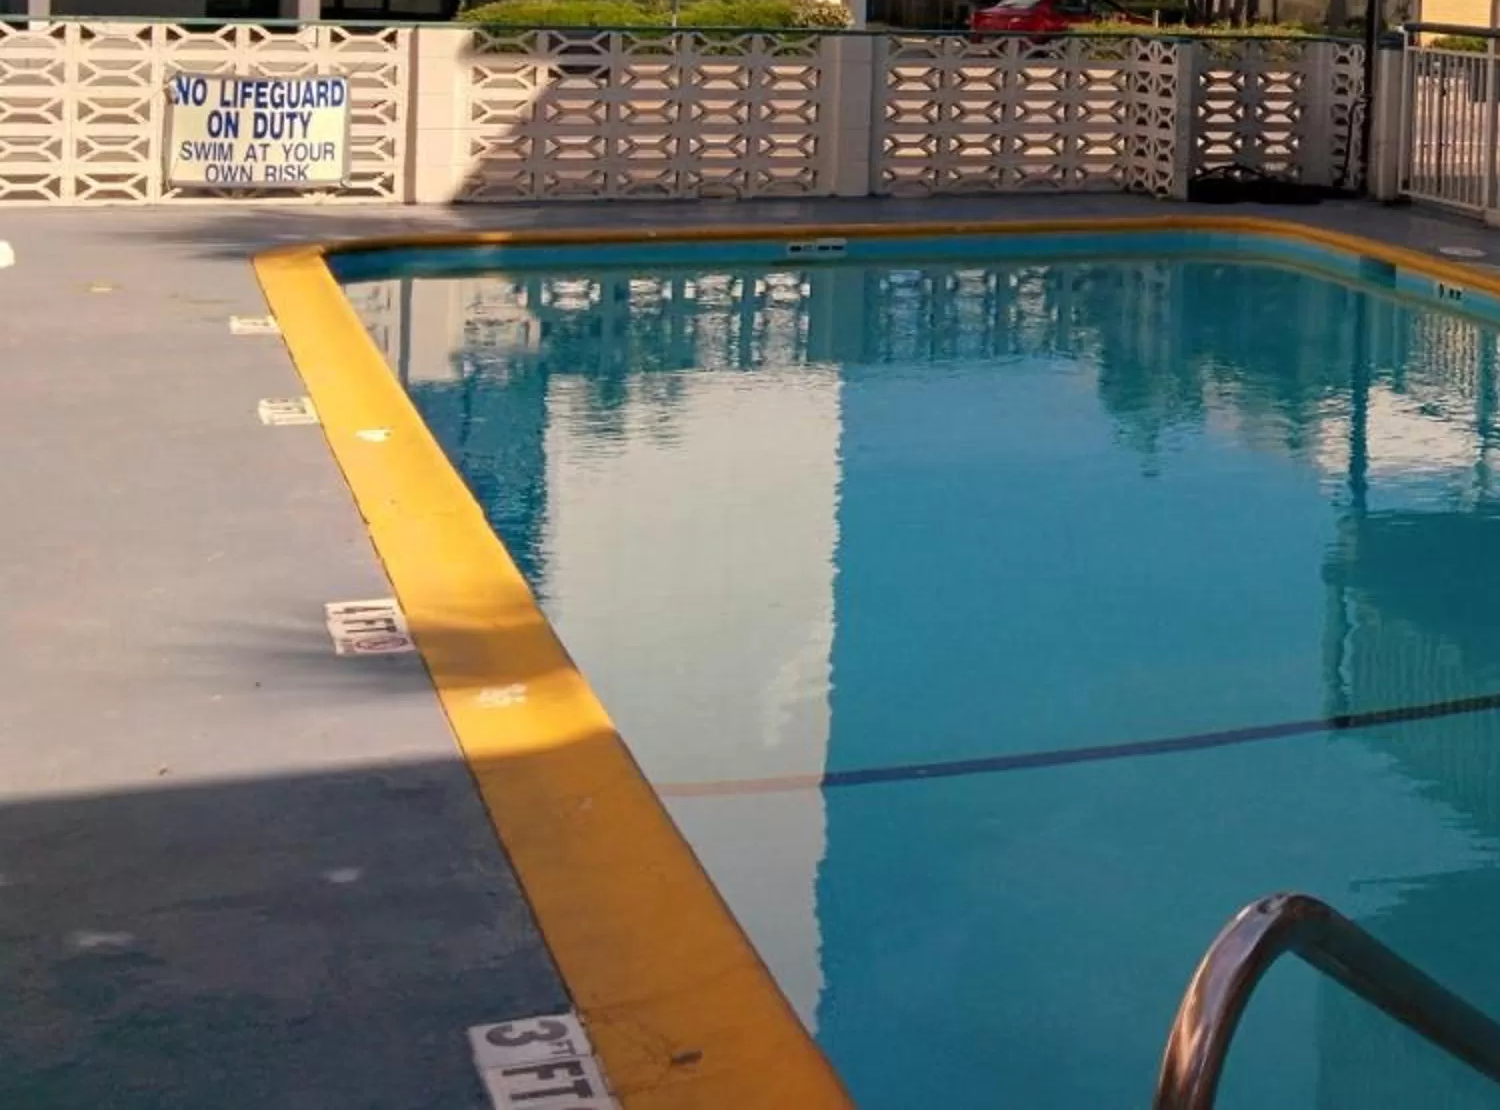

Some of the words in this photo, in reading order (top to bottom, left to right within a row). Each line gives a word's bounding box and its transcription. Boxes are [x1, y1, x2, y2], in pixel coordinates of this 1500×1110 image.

[174, 75, 207, 106] NO
[220, 79, 345, 108] LIFEGUARD
[207, 110, 240, 139] ON
[253, 111, 313, 140] DUTY
[179, 141, 234, 161] SWIM
[244, 143, 271, 162] AT
[282, 142, 335, 161] YOUR
[205, 164, 253, 183] OWN
[264, 164, 310, 182] RISK
[485, 1019, 569, 1047] 3
[501, 1060, 594, 1101] FT
